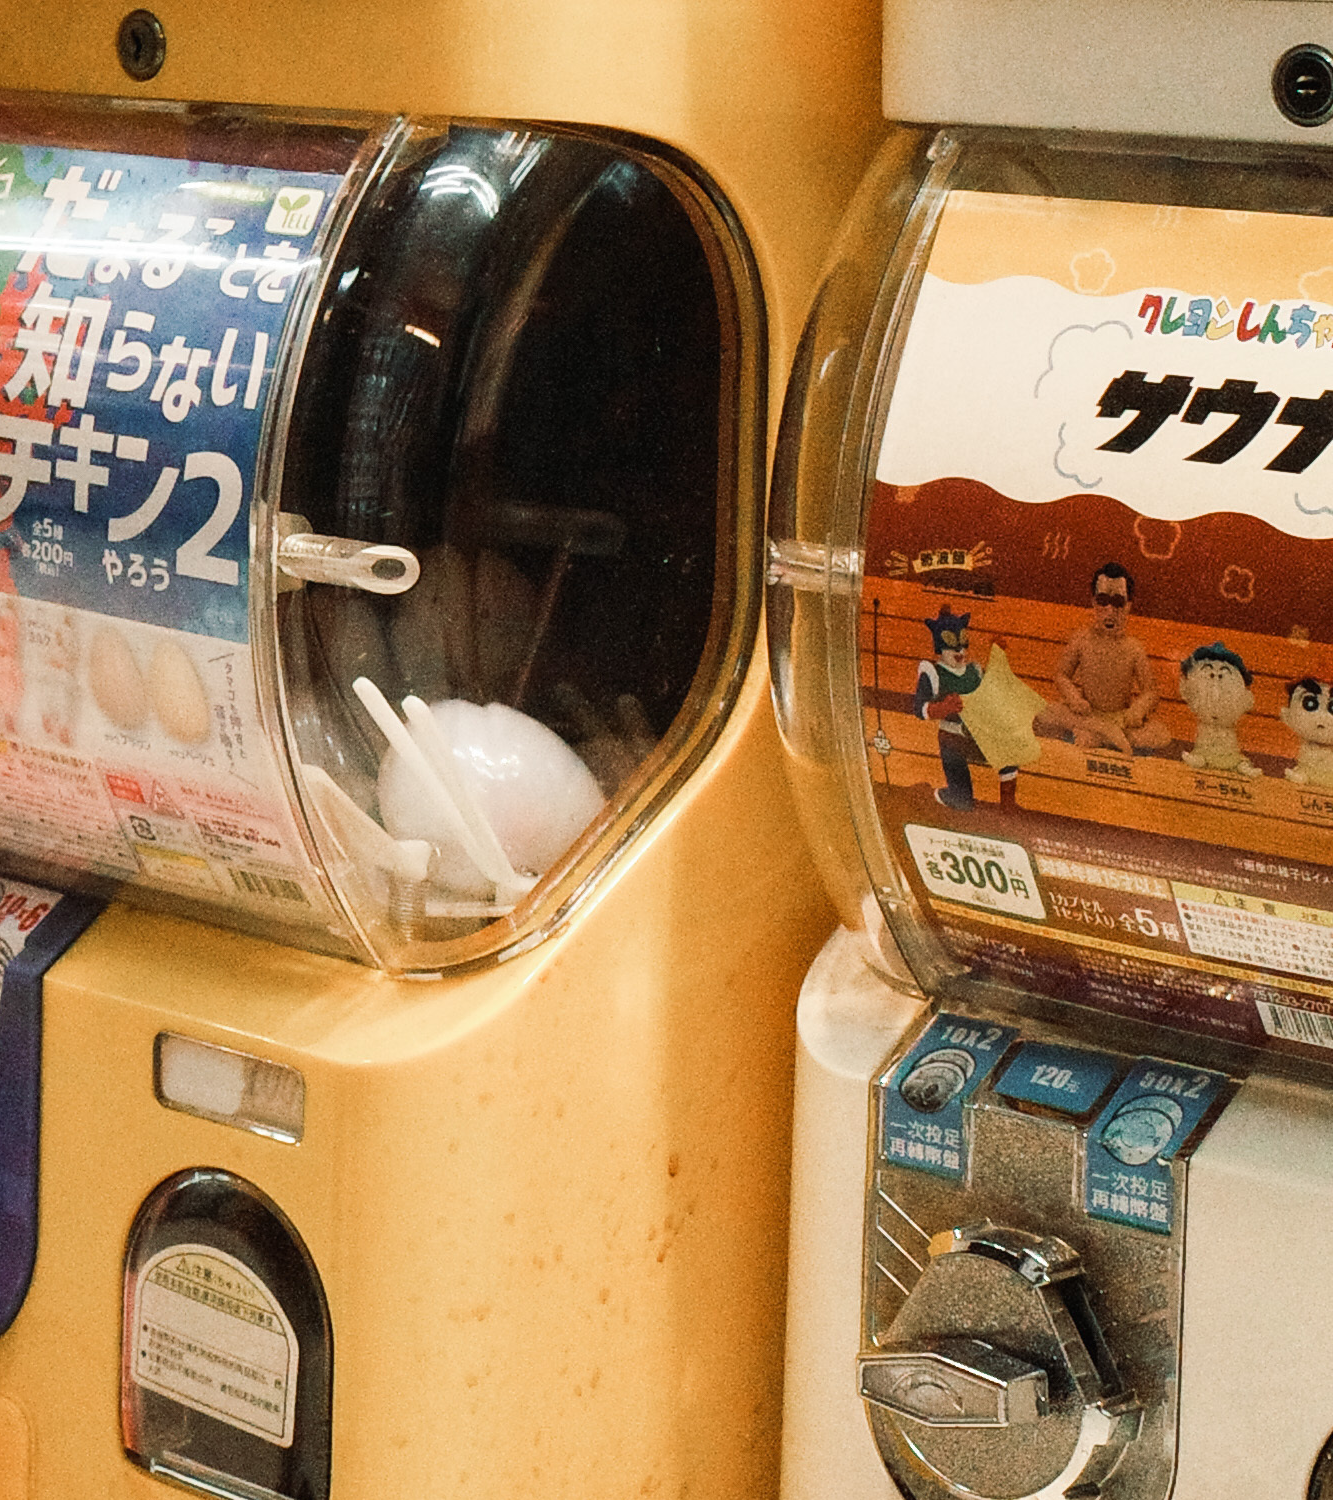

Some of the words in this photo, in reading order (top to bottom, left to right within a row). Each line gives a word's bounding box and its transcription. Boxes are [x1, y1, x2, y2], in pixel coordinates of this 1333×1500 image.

[1138, 294, 1333, 349] クレヨンしんちゃ
[2, 281, 269, 424] 知らない
[1095, 370, 1333, 475] サウナ
[32, 518, 64, 541] 全5種
[102, 548, 171, 591] やろう
[926, 851, 1030, 900] 各300円
[1118, 905, 1180, 943] 全5種
[890, 1120, 961, 1147] 一次投足
[890, 1137, 961, 1170] 再轉幣盤
[1091, 1188, 1169, 1223] 再轉幣盤
[1092, 1171, 1168, 1202] 一次投足
